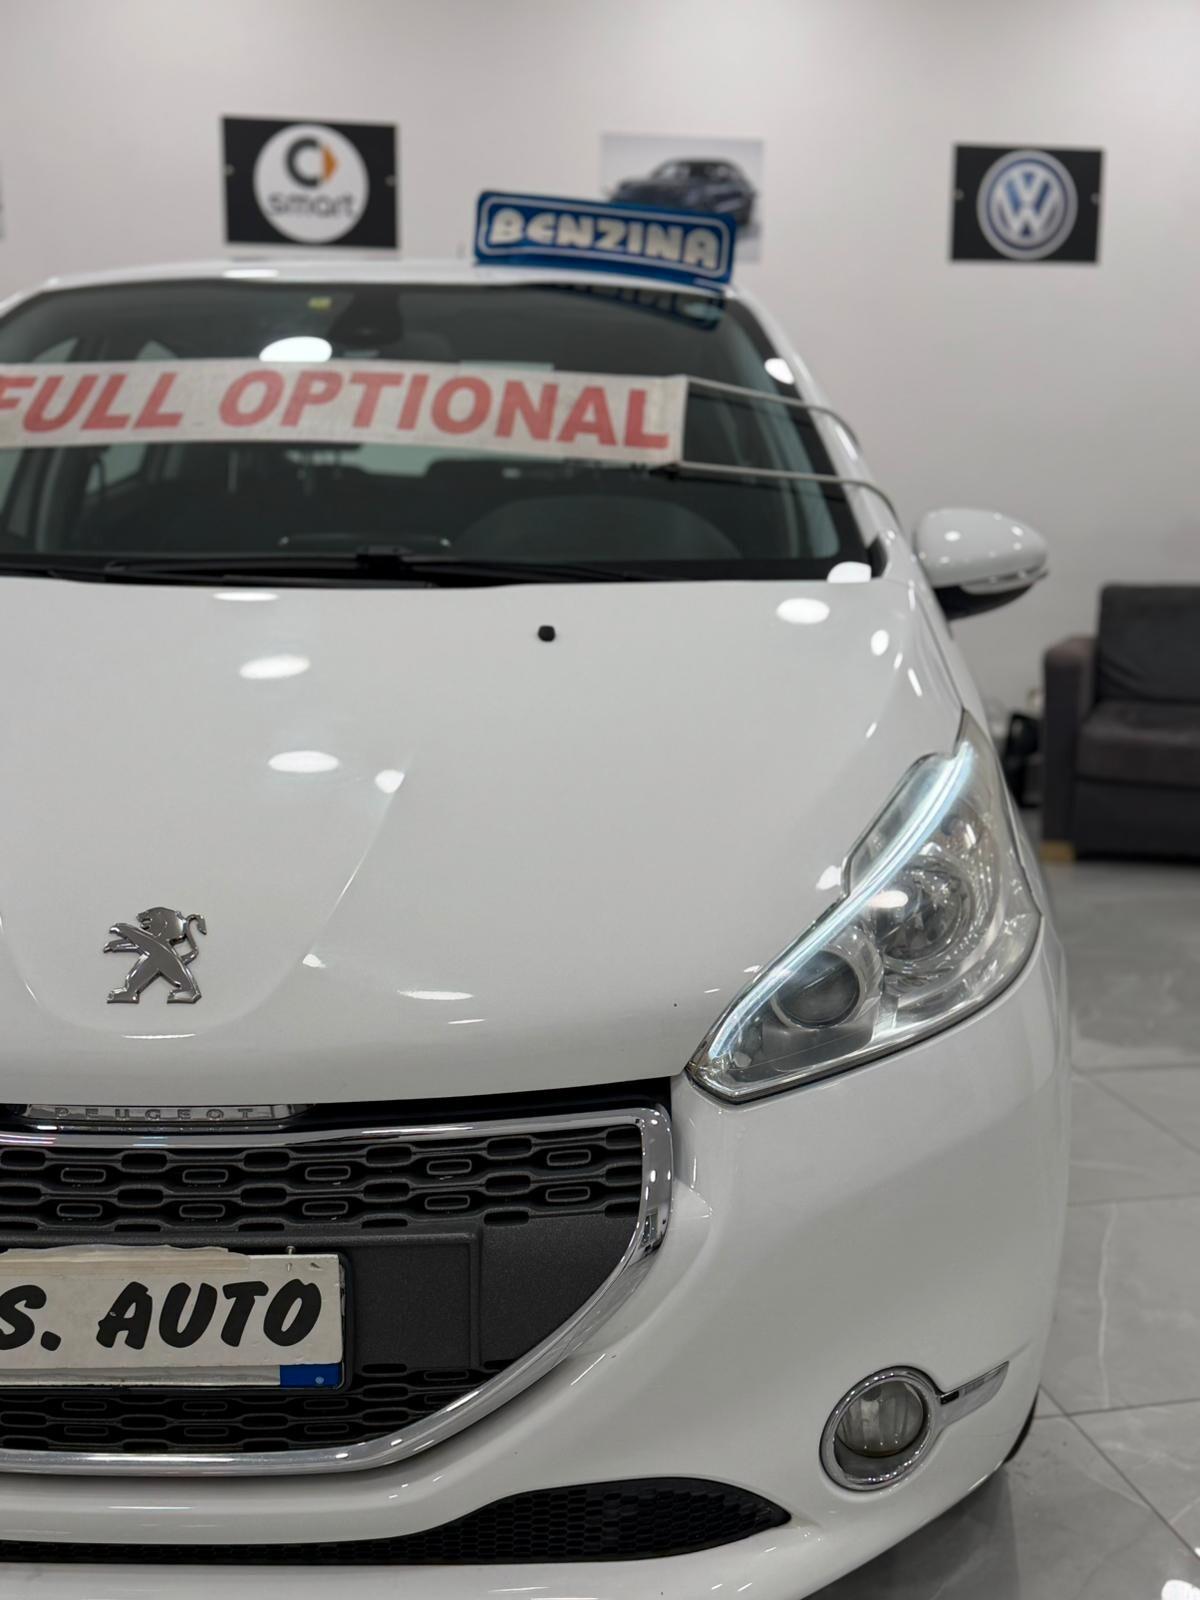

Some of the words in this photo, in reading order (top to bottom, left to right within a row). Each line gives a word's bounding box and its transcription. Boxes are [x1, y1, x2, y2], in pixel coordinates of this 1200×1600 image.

[268, 192, 355, 219] smart
[488, 207, 720, 270] BENZINA
[218, 369, 669, 449] OPTIONAL
[54, 1107, 254, 1122] PEUGEOT
[96, 1278, 322, 1350] AUTO
